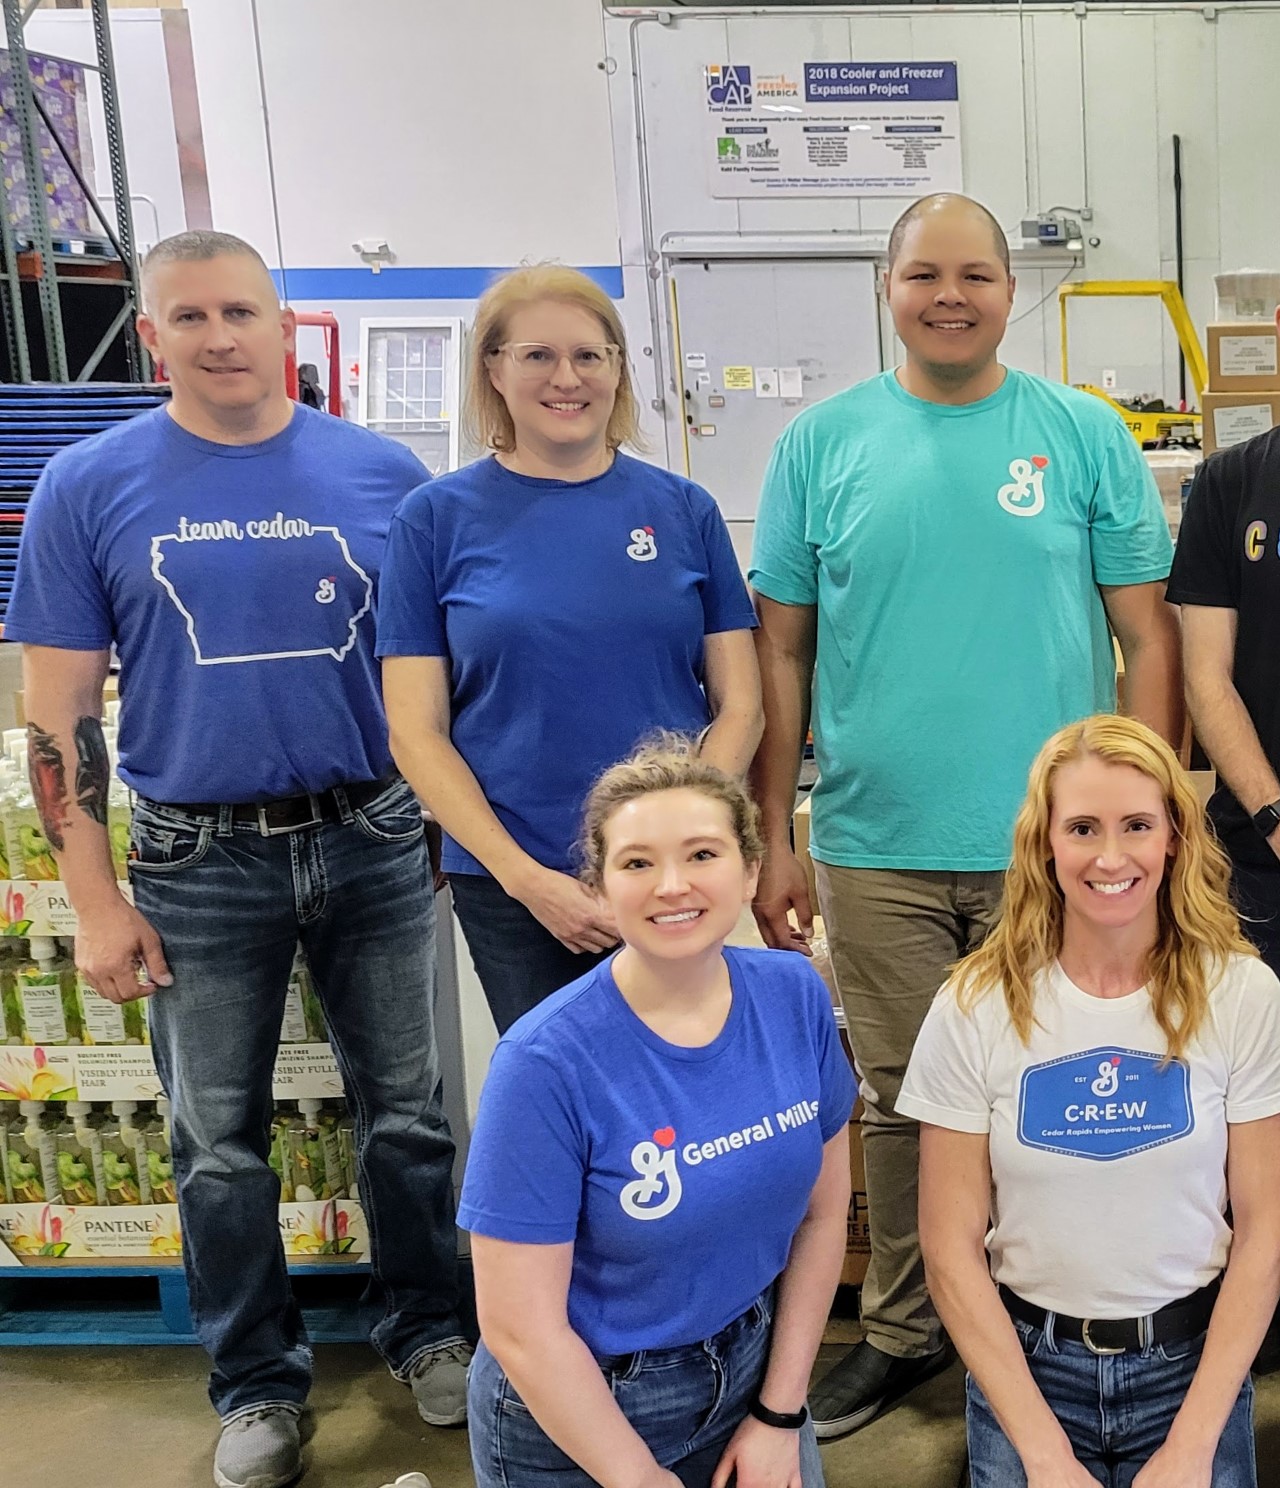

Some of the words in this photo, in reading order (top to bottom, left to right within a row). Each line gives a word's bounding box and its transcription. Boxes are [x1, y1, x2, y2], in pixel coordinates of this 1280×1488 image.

[809, 68, 837, 79] 2018
[840, 67, 876, 79] Cooler
[879, 67, 900, 78] and
[902, 67, 944, 78] Freezer
[810, 83, 866, 97] Expansion
[869, 83, 909, 97] Project
[177, 516, 243, 542] team
[246, 512, 314, 540] cedar
[79, 1069, 118, 1078] VISIBLY
[81, 1079, 107, 1087] HAIR
[682, 1116, 775, 1166] General
[776, 1100, 819, 1133] Mills
[1042, 1128, 1065, 1137] Cedar
[1066, 1127, 1093, 1137] Rapids
[1094, 1125, 1142, 1136] Empowering
[1143, 1123, 1172, 1131] Women
[85, 1220, 153, 1233] PANTENE
